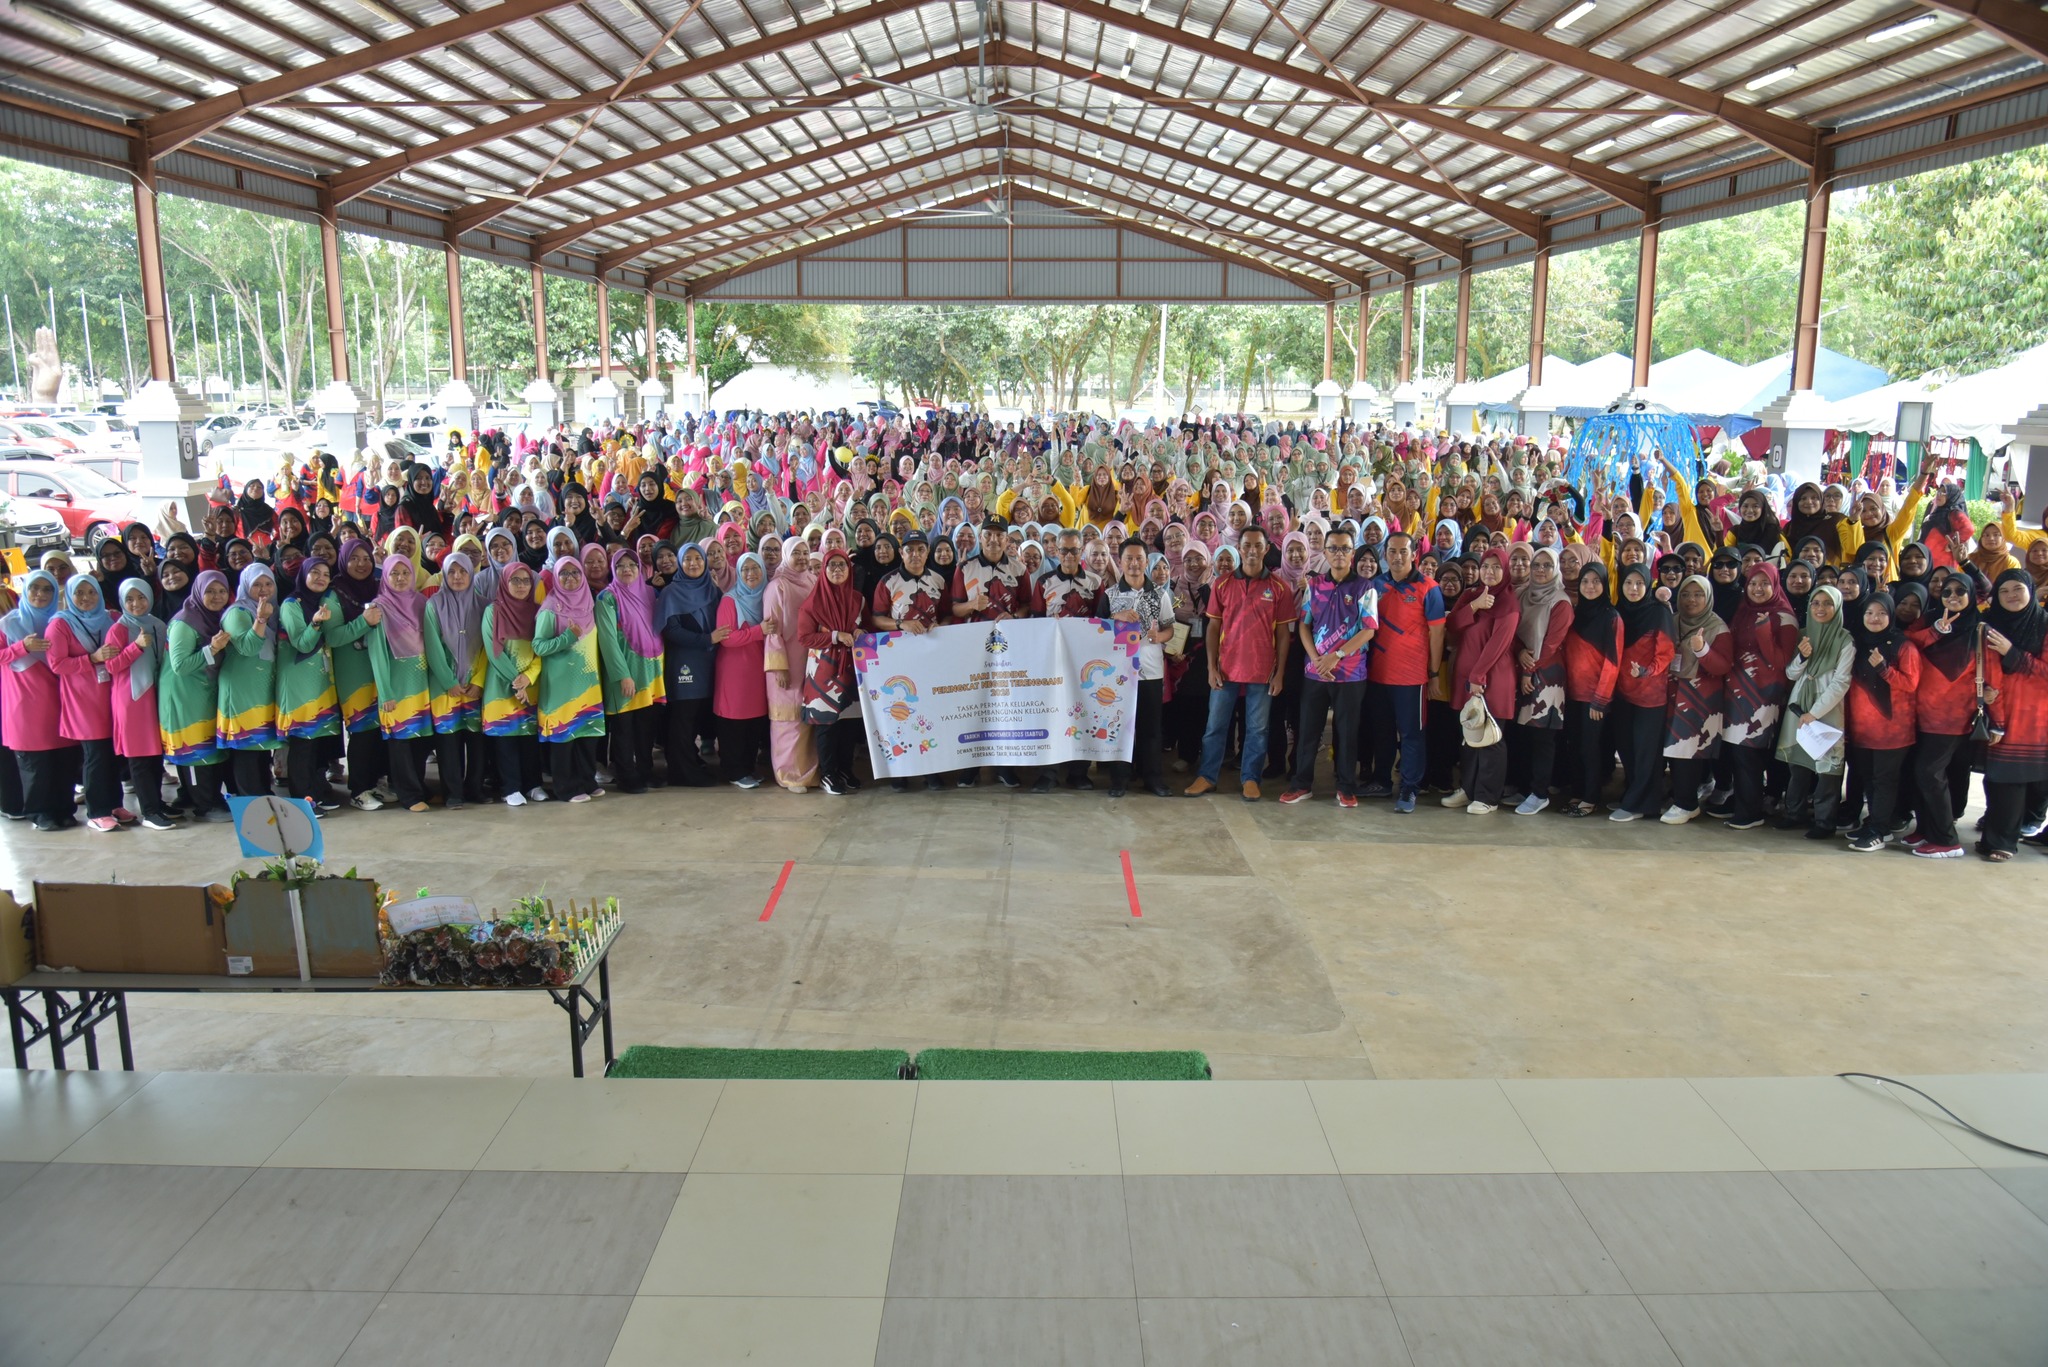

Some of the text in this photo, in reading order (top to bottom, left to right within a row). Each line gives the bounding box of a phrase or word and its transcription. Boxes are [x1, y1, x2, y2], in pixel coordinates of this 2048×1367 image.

[969, 672, 990, 682] HARI
[932, 682, 980, 695] PERINGKAT
[1010, 677, 1063, 687] TERENGGANU
[941, 706, 1060, 721] YAYASAN PEMBANGUNAN KELUARGA
[957, 704, 979, 712] TASKA
[1010, 700, 1045, 708] KELUARGA
[1065, 725, 1083, 740] ABC
[919, 738, 938, 755] ABC
